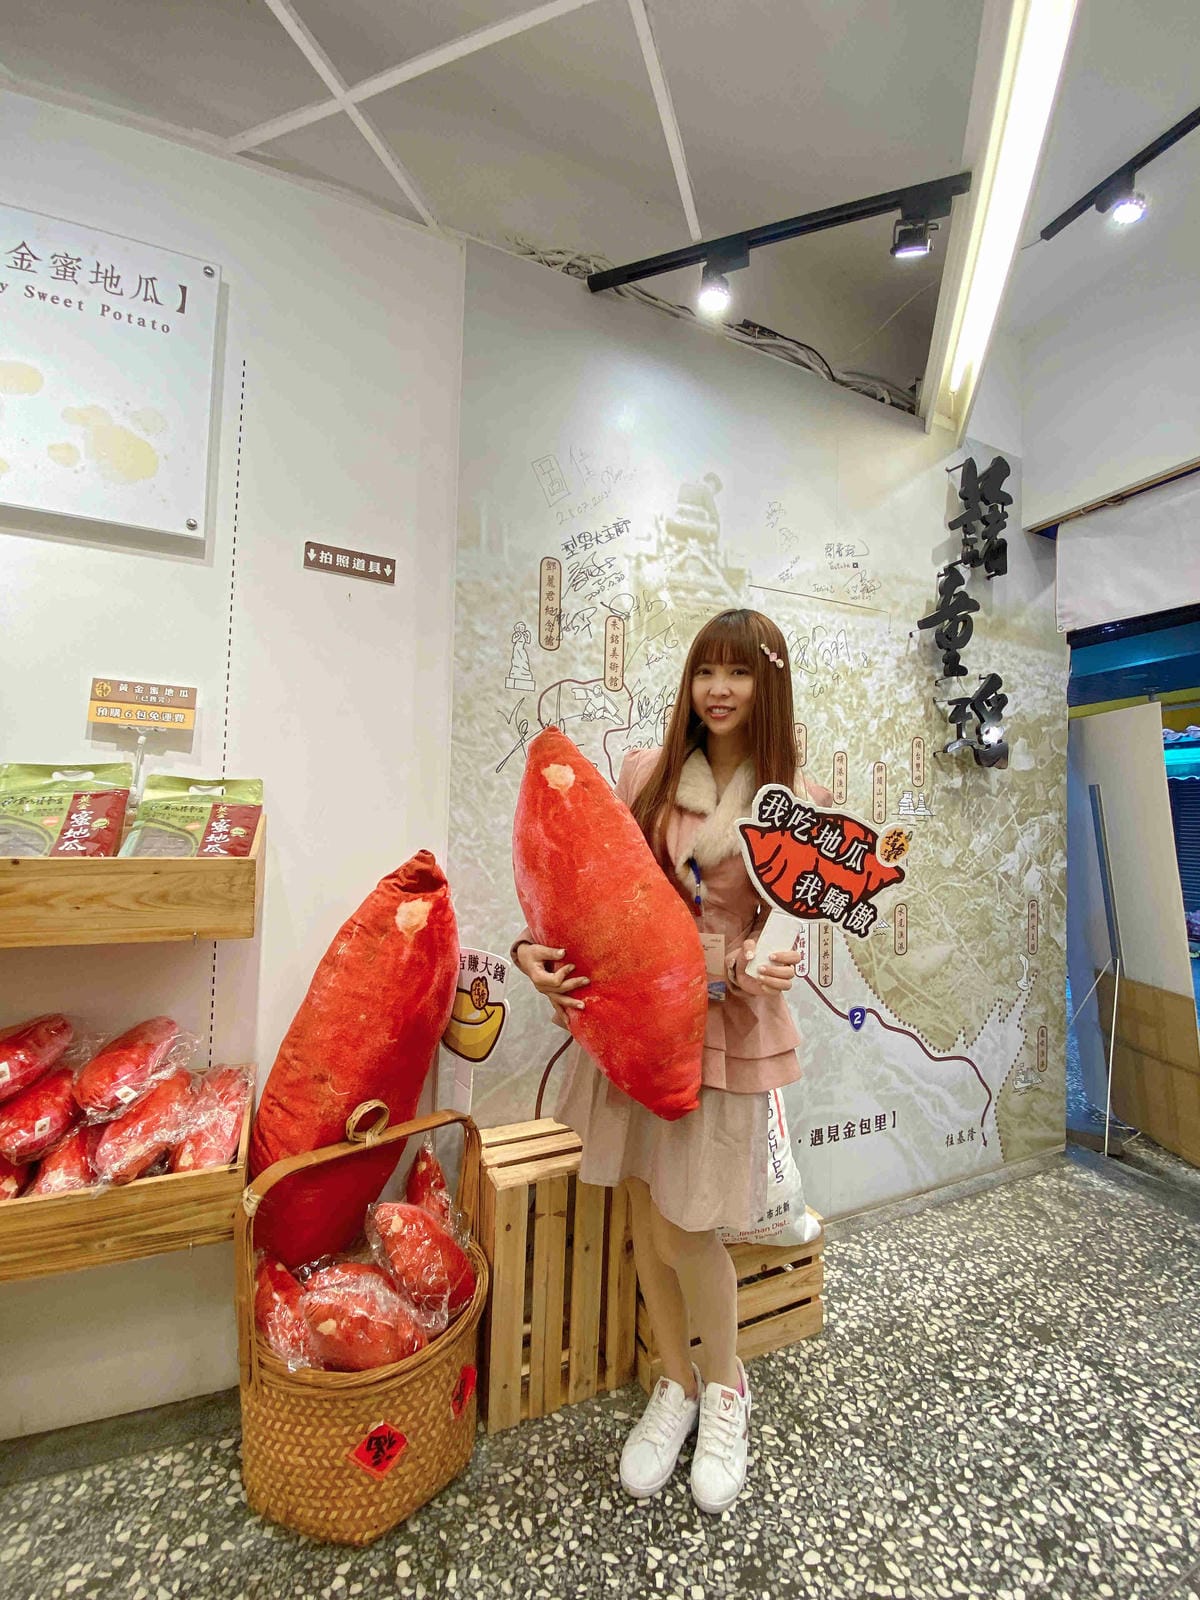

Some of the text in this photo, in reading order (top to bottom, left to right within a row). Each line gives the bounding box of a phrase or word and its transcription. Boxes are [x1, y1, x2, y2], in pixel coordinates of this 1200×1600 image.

[24, 284, 85, 312] Sweet
[100, 303, 171, 334] Potato
[319, 550, 382, 575] 拍照道具
[609, 618, 620, 687] 朱銘美術館
[761, 792, 869, 872] 我吃地瓜
[795, 873, 877, 935] 我驕傲
[854, 1011, 862, 1025] 2
[767, 1129, 785, 1184] CHIPS
[945, 1127, 977, 1149] 往基隆
[772, 1219, 791, 1230] Dist.
